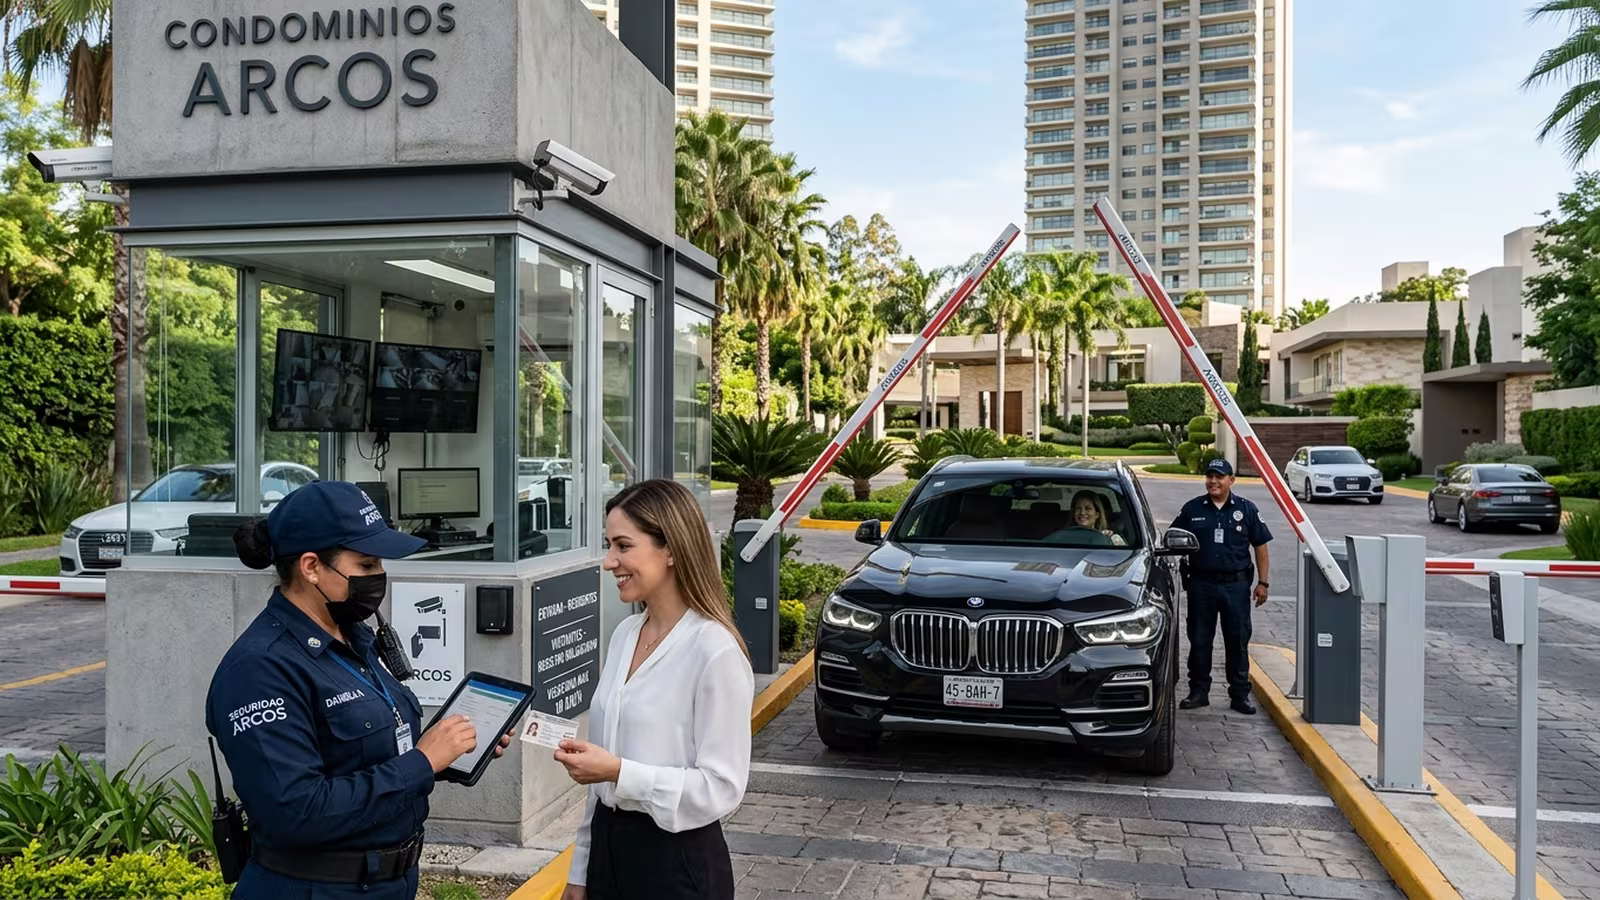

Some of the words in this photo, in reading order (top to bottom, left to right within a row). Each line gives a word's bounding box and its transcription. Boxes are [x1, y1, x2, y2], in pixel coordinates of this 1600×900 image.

[164, 2, 456, 50] CONDOMINIOS
[182, 48, 438, 117] ARCOS
[412, 669, 452, 682] RCOS
[233, 707, 287, 736] ARCOS
